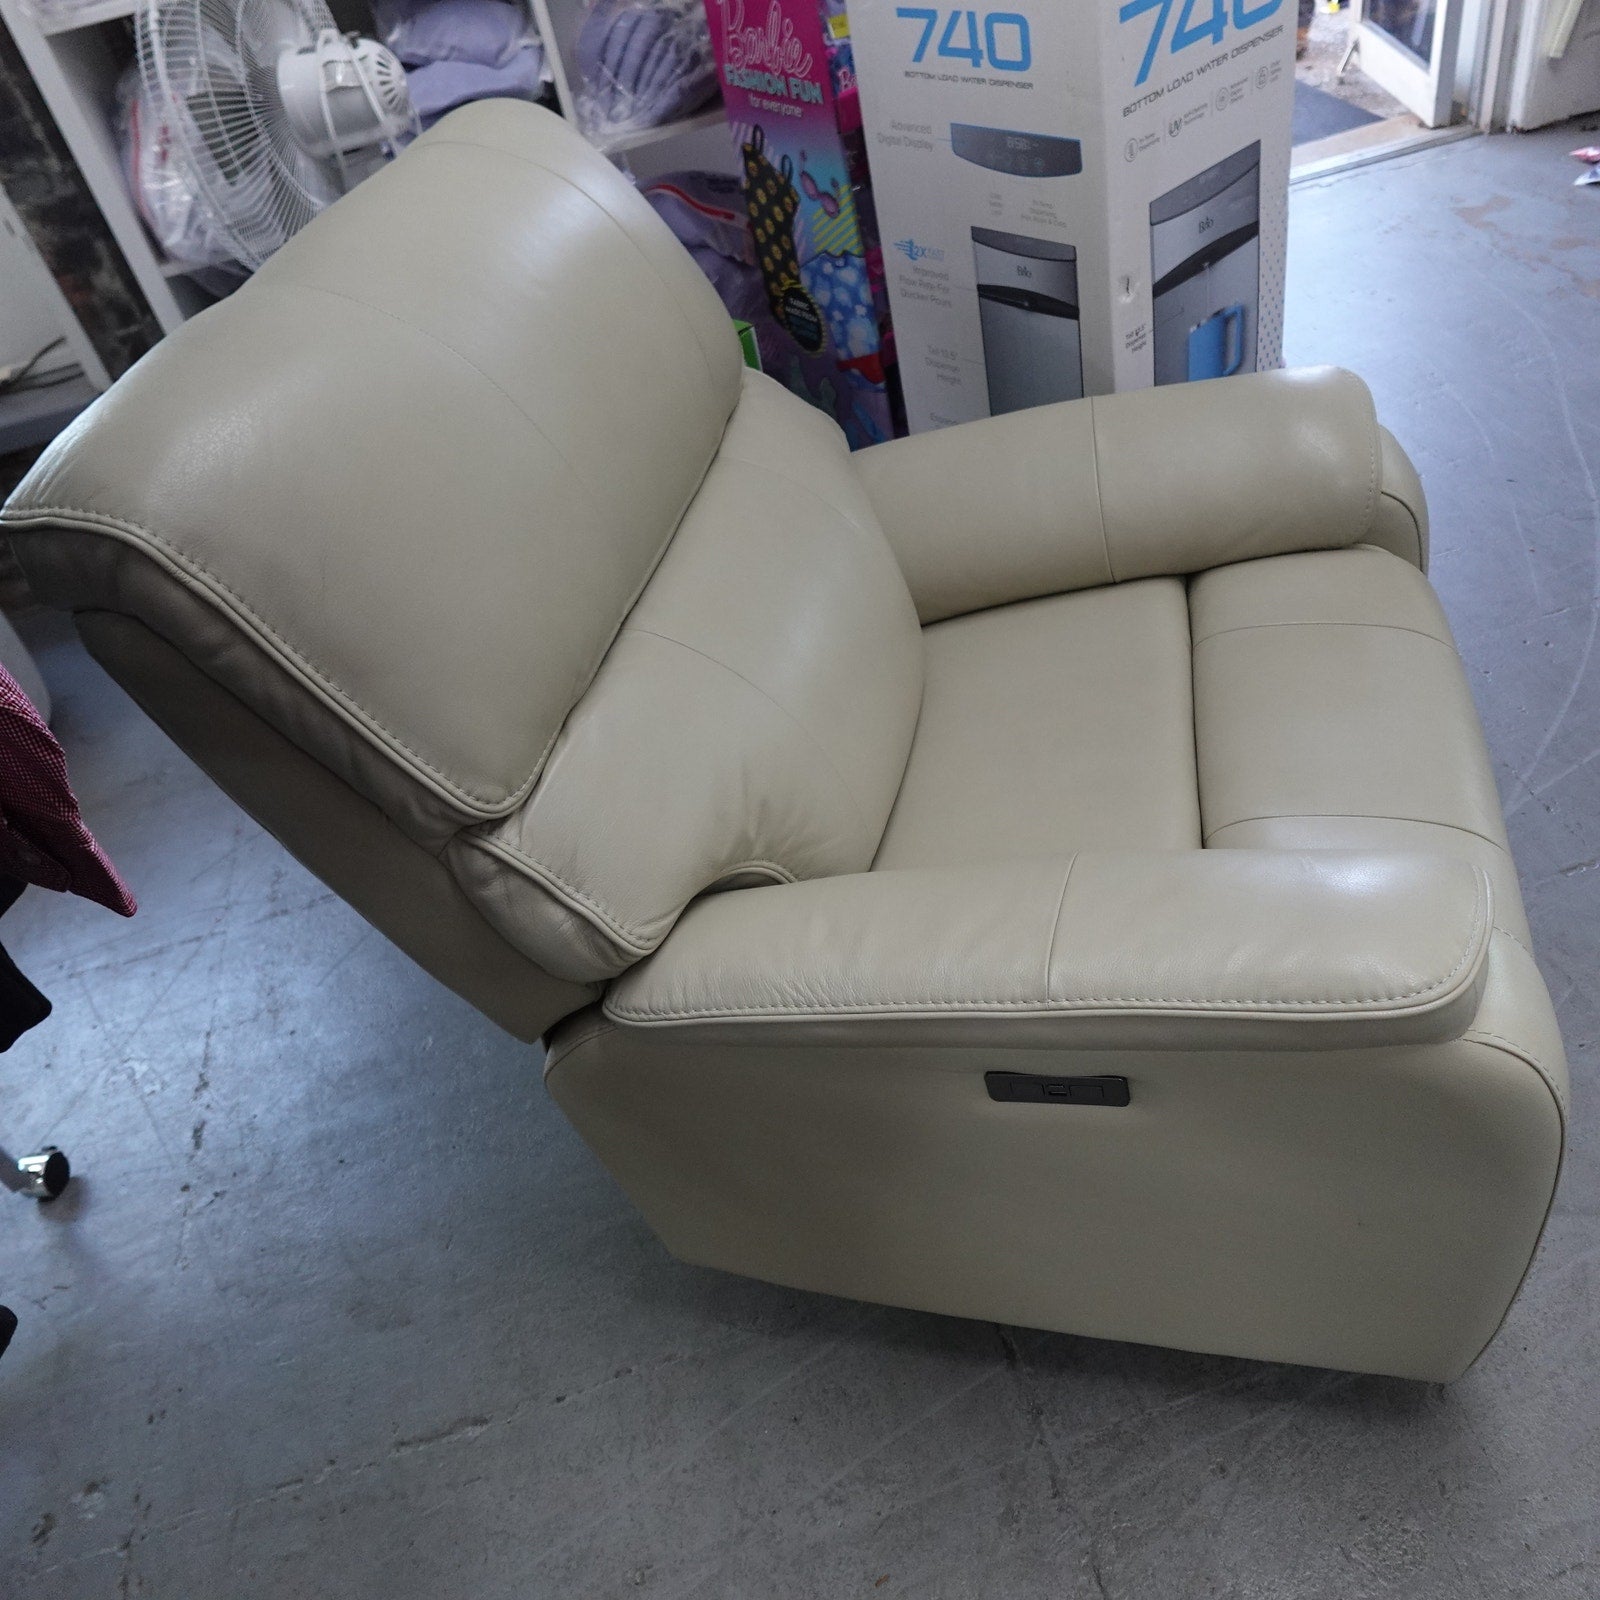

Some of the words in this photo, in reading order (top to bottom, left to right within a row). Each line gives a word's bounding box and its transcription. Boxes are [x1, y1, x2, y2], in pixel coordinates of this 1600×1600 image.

[717, 0, 813, 78] Barbie
[896, 7, 1032, 72] 740
[1122, 88, 1165, 117] BOTTOM
[1167, 70, 1194, 93] LOAD
[1196, 52, 1229, 76] WATER
[1231, 24, 1285, 59] DISPENSER
[723, 63, 788, 98] FASHION
[789, 77, 824, 104] FUN
[904, 70, 936, 81] BOTTOM
[938, 74, 959, 83] LOAD
[960, 76, 986, 86] WATER
[989, 79, 1034, 90] DISPENSER
